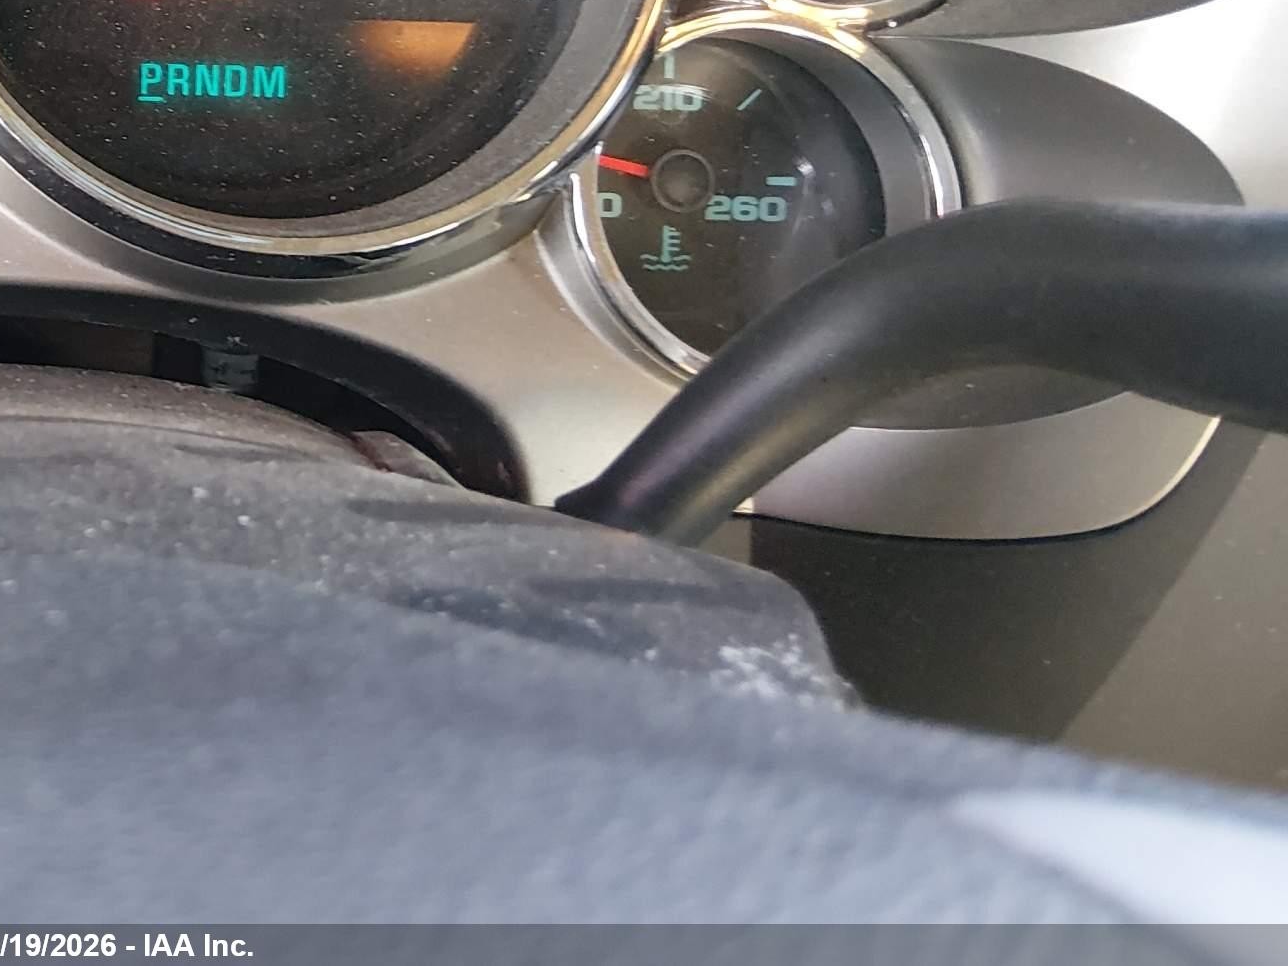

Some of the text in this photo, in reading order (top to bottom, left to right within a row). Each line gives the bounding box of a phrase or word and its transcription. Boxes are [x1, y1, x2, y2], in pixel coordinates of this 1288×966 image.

[138, 62, 286, 101] PRNDM
[633, 84, 703, 111] 210
[705, 196, 787, 222] 260
